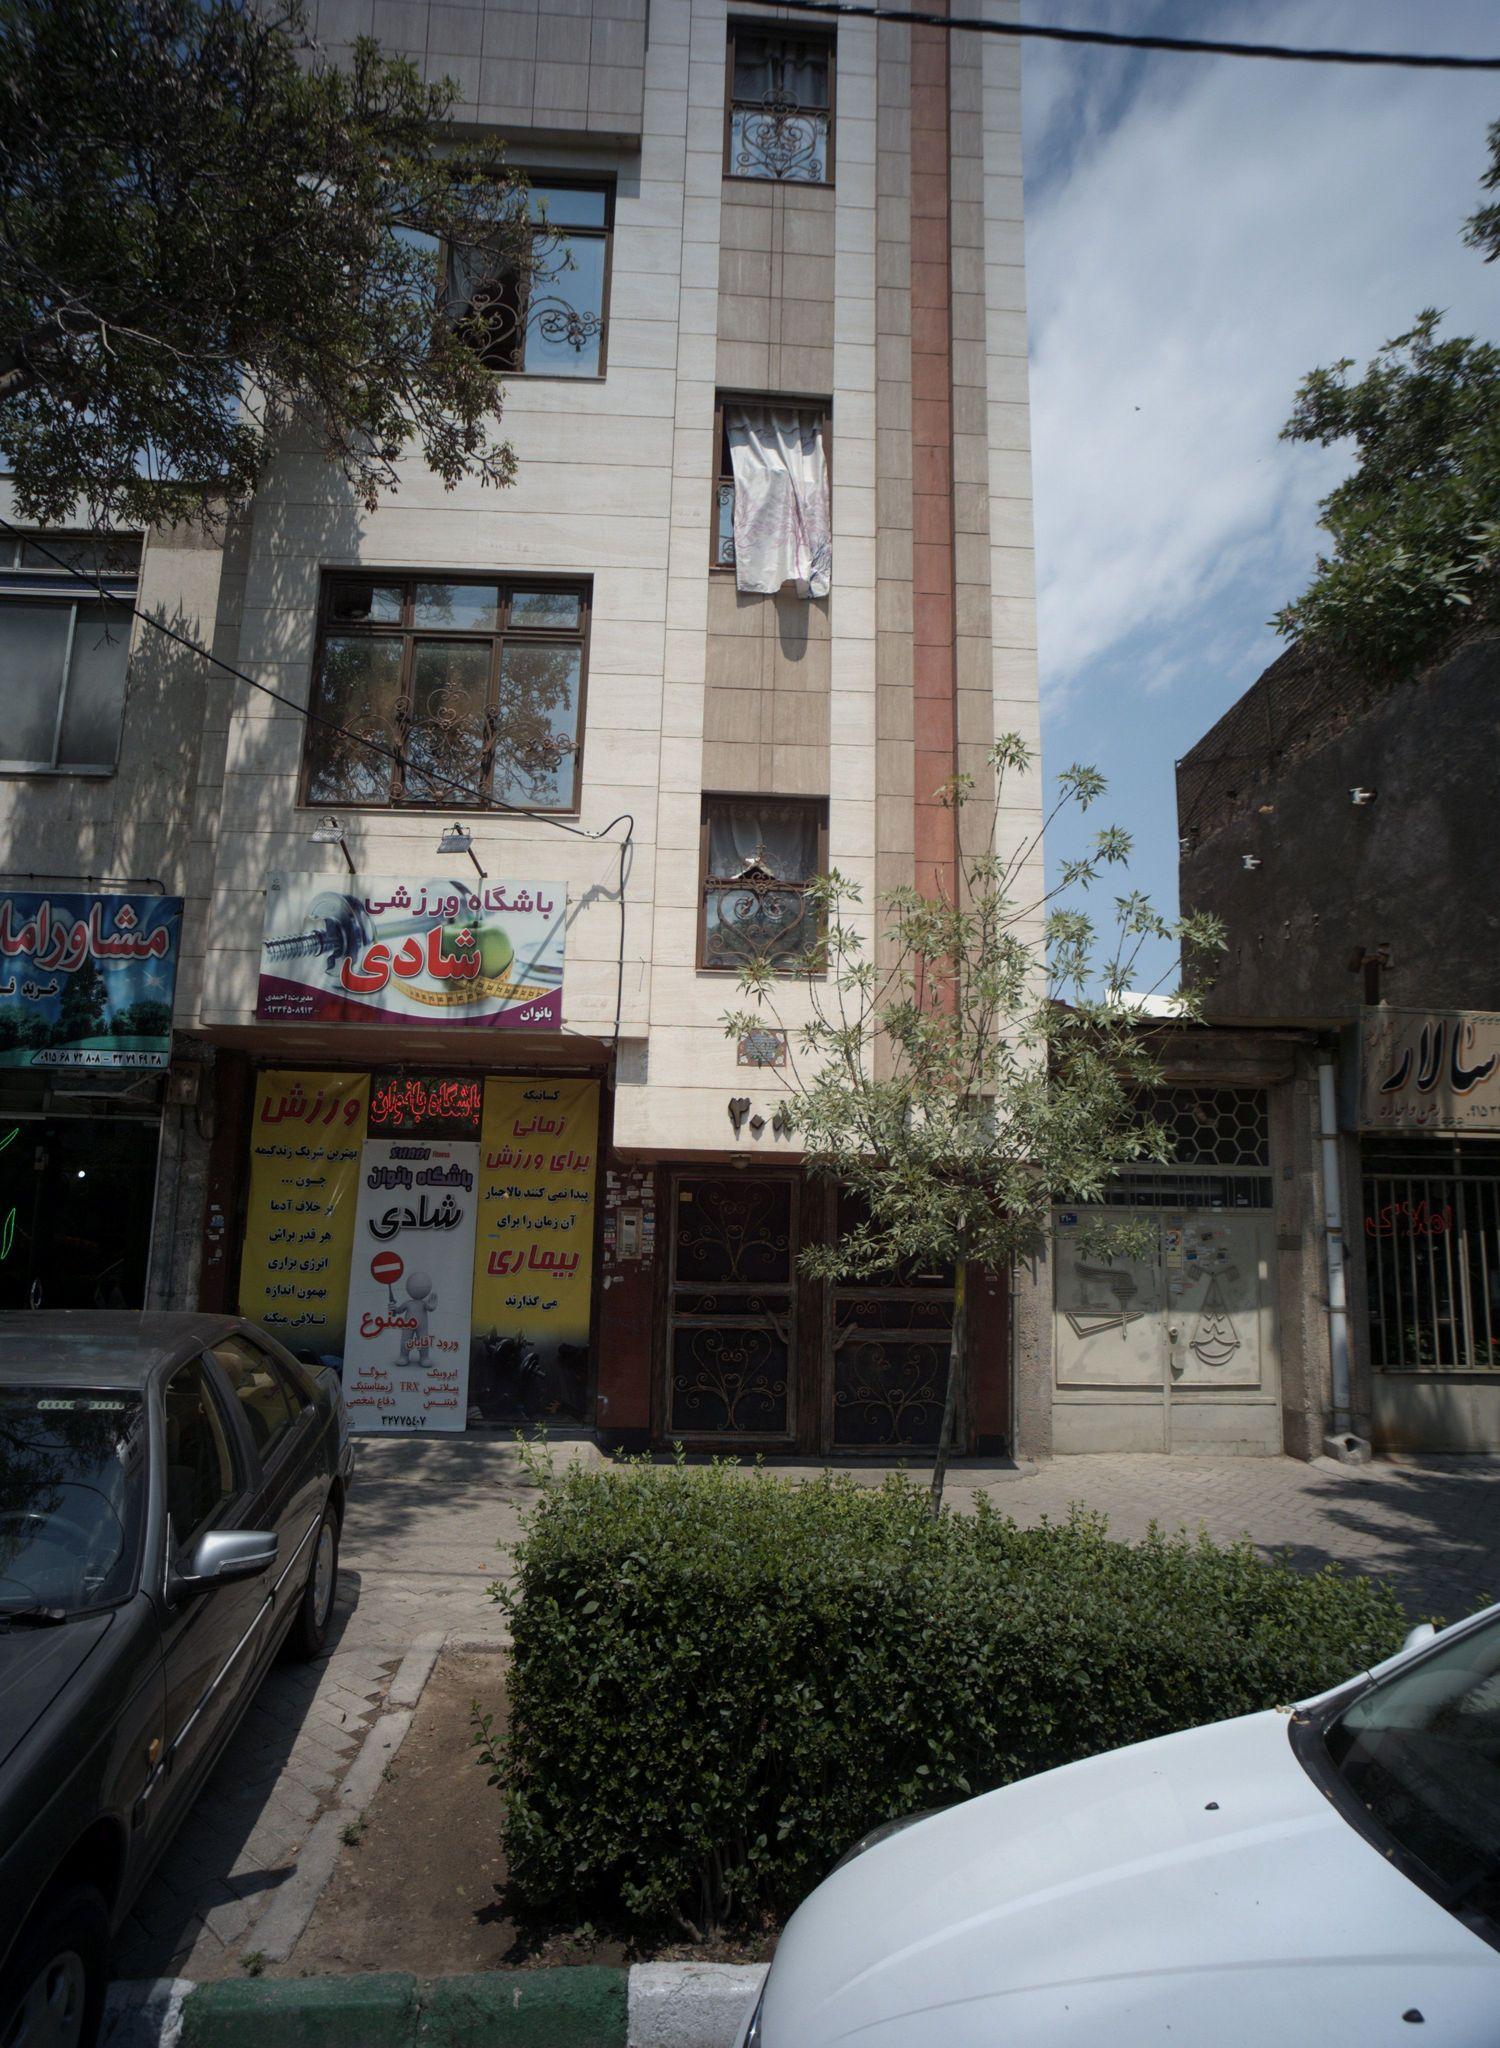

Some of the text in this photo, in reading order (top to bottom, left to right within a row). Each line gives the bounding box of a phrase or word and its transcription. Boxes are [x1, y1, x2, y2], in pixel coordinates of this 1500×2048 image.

[365, 885, 554, 920] باشگاه ورزشی
[33, 902, 169, 971] مشاور
[341, 925, 481, 994] شادی
[21, 979, 59, 1000] خرید
[519, 1006, 553, 1021] بانوان
[86, 1053, 100, 1063] ۸۰۸
[261, 1083, 362, 1127] ورزش
[371, 1079, 481, 1125] باشگاه بانوان
[512, 1115, 567, 1137] زمانی
[295, 1147, 324, 1160] شریک
[326, 1147, 359, 1161] بهترین
[486, 1144, 591, 1172] برای ورزش
[368, 1163, 474, 1192] باشگاه بانوان
[270, 1199, 293, 1211] آدما
[295, 1200, 320, 1212] خلاف
[368, 1194, 465, 1241] شادی
[496, 1214, 577, 1230] آن زمان را برای
[298, 1228, 316, 1243] قدر
[319, 1231, 332, 1243] هر
[487, 1243, 581, 1279] بیماری
[264, 1284, 295, 1298] اندازه
[541, 1300, 559, 1311] می
[359, 1311, 419, 1339] ممنوع
[405, 1335, 460, 1352] ورود آقایان
[400, 1381, 420, 1393] TRX
